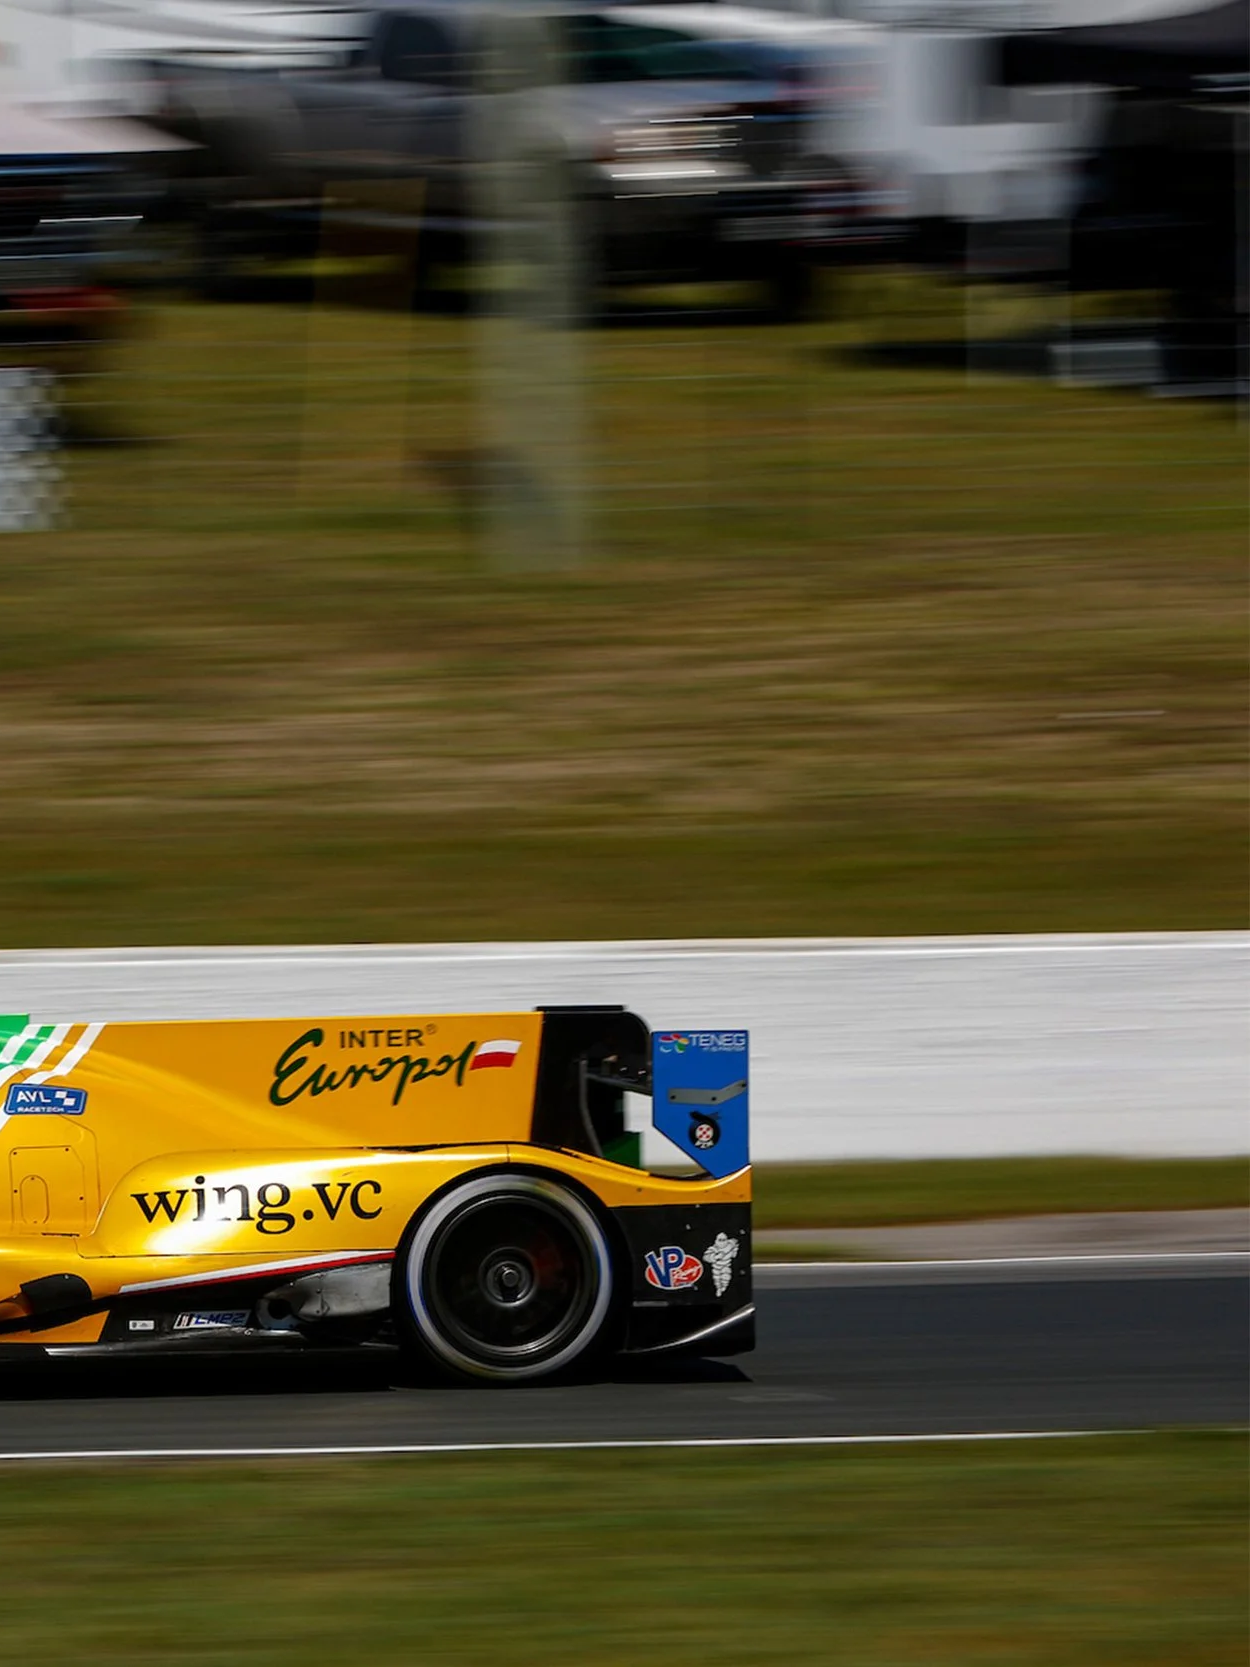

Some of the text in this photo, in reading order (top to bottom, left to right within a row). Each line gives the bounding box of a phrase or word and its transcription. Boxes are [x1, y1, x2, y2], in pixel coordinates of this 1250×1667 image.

[340, 1028, 424, 1048] INTER
[688, 1033, 746, 1047] TENEG
[269, 1028, 477, 1106] Europol
[16, 1090, 52, 1103] AVL
[130, 1175, 383, 1235] wing.vc
[194, 1311, 247, 1325] LMP2
